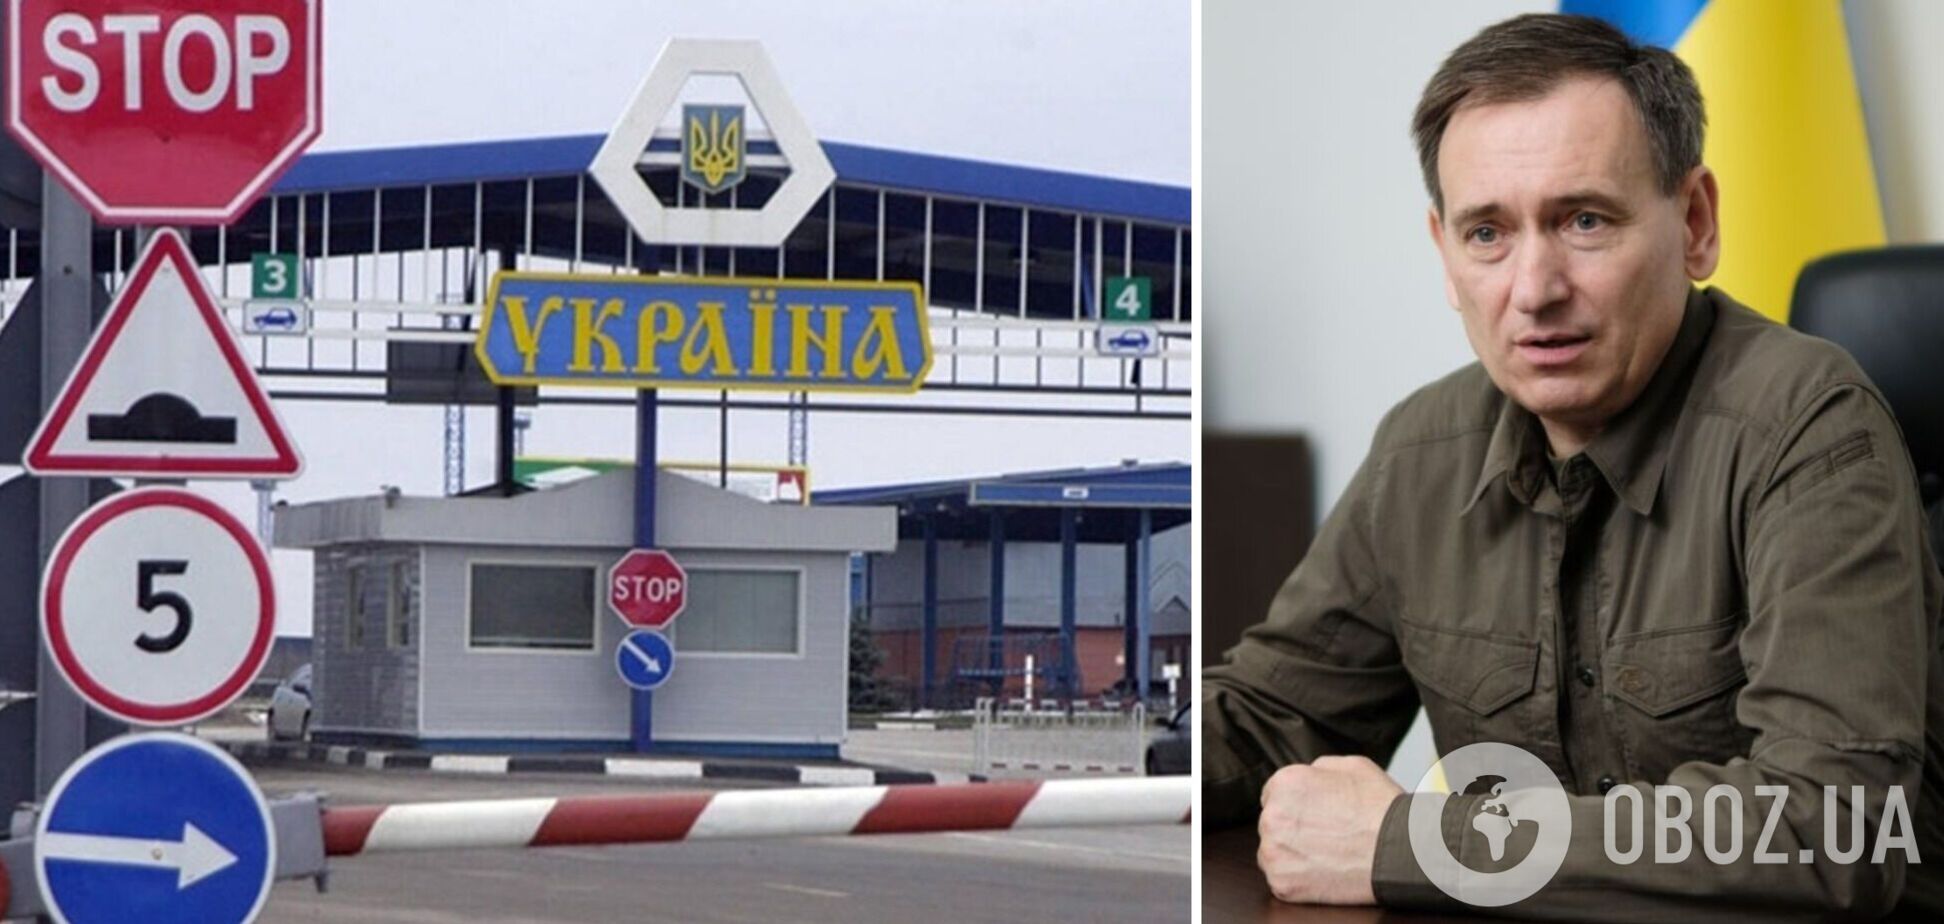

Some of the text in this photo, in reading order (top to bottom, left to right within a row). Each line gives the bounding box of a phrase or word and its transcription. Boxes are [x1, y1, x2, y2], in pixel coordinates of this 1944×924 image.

[41, 13, 291, 112] STOP
[263, 259, 287, 293] 3
[1115, 283, 1141, 316] 4
[501, 289, 912, 380] УКРАЇНА
[134, 560, 193, 654] 5
[614, 575, 682, 602] STOP
